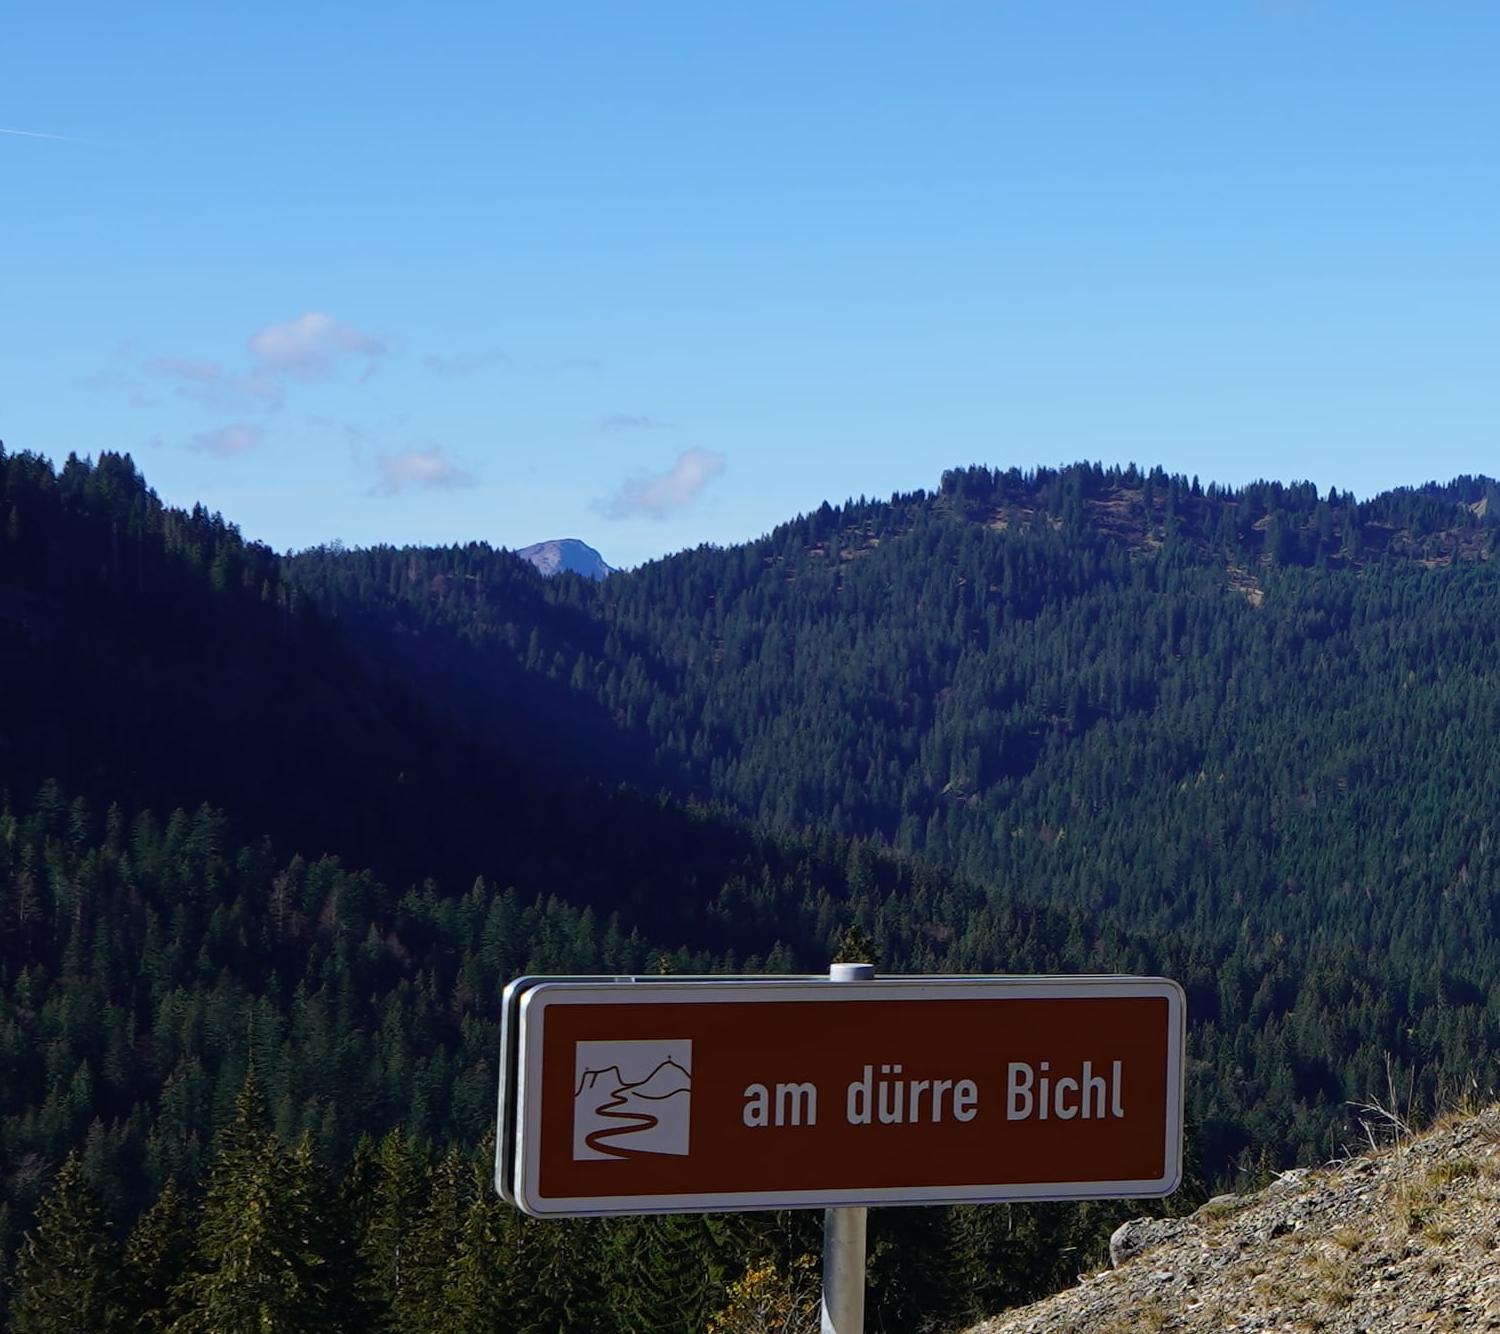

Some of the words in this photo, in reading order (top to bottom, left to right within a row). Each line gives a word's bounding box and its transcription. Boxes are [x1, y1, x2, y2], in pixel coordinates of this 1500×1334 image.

[742, 1081, 817, 1127] am
[846, 1065, 979, 1125] dürre
[1006, 1059, 1124, 1121] Bichl
